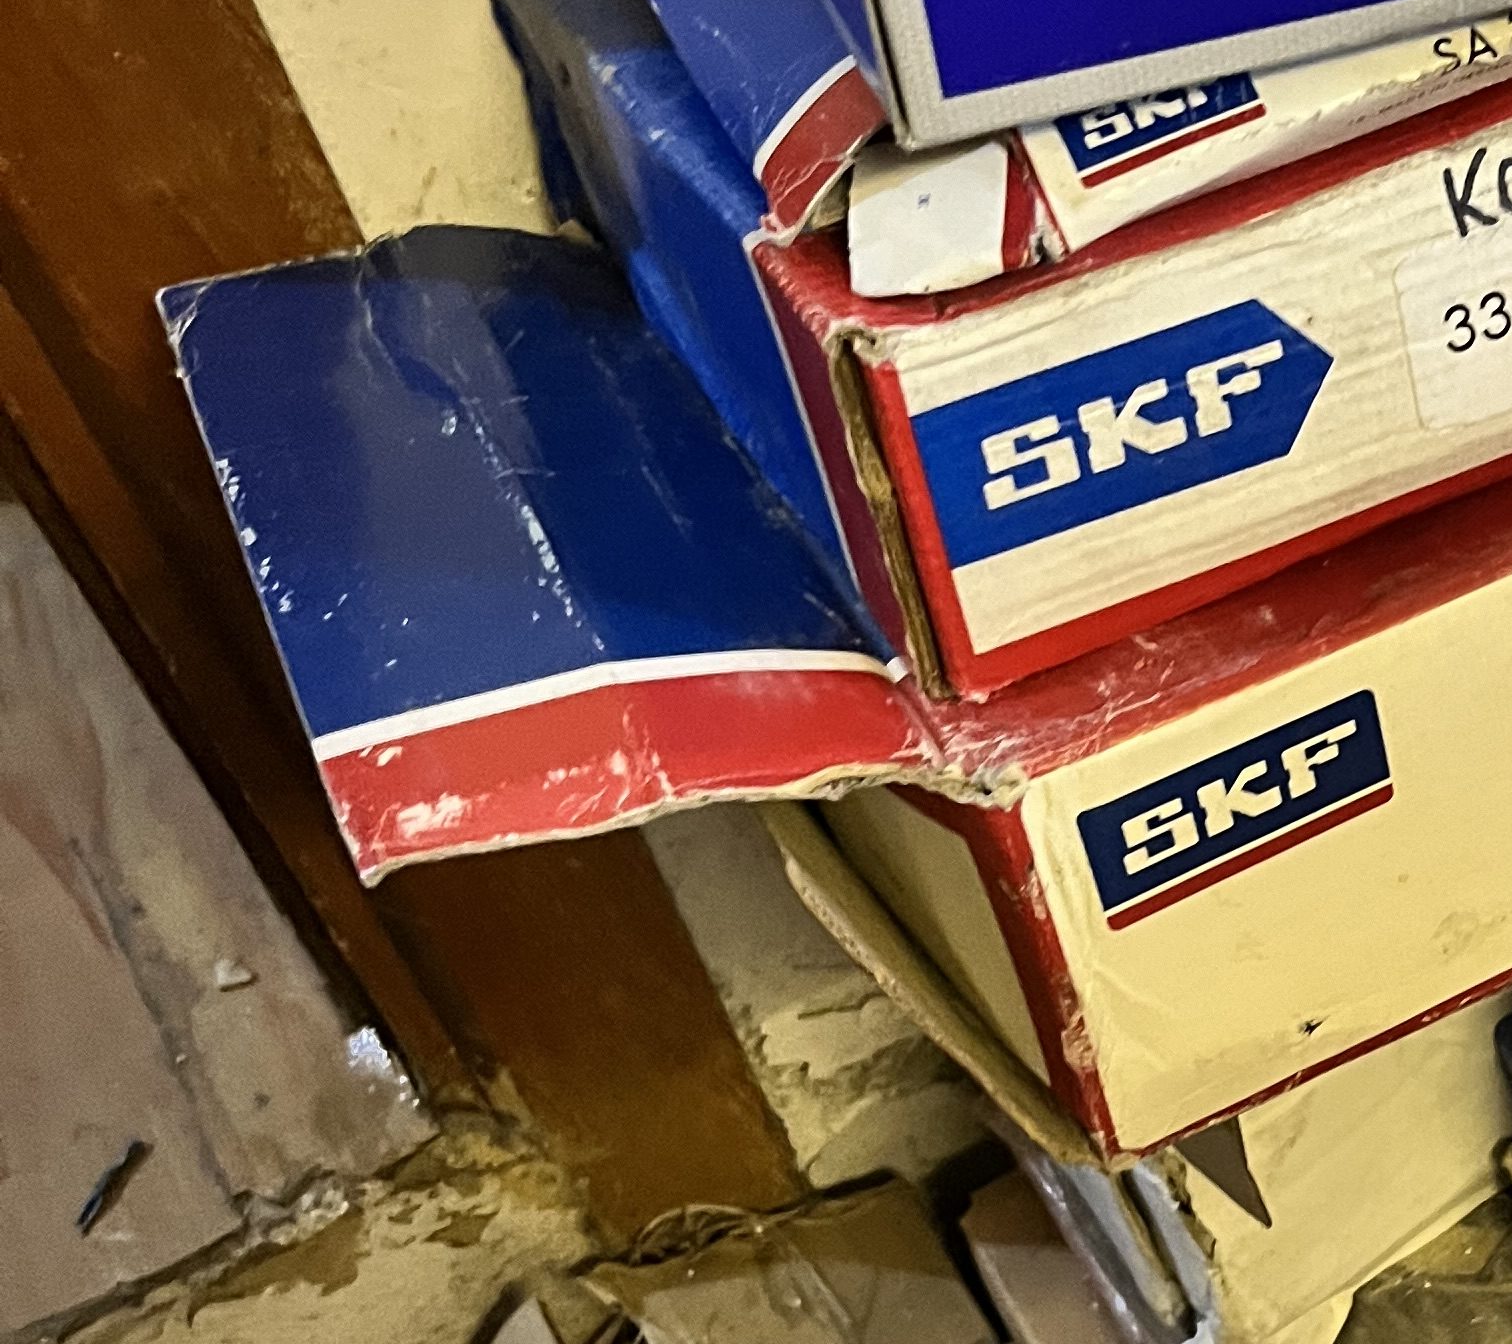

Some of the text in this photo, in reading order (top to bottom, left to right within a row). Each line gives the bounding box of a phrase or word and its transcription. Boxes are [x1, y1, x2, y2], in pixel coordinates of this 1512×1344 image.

[1433, 26, 1497, 71] SA
[1082, 84, 1208, 150] SK
[981, 338, 1284, 510] SKF
[1121, 718, 1357, 876] SKF
